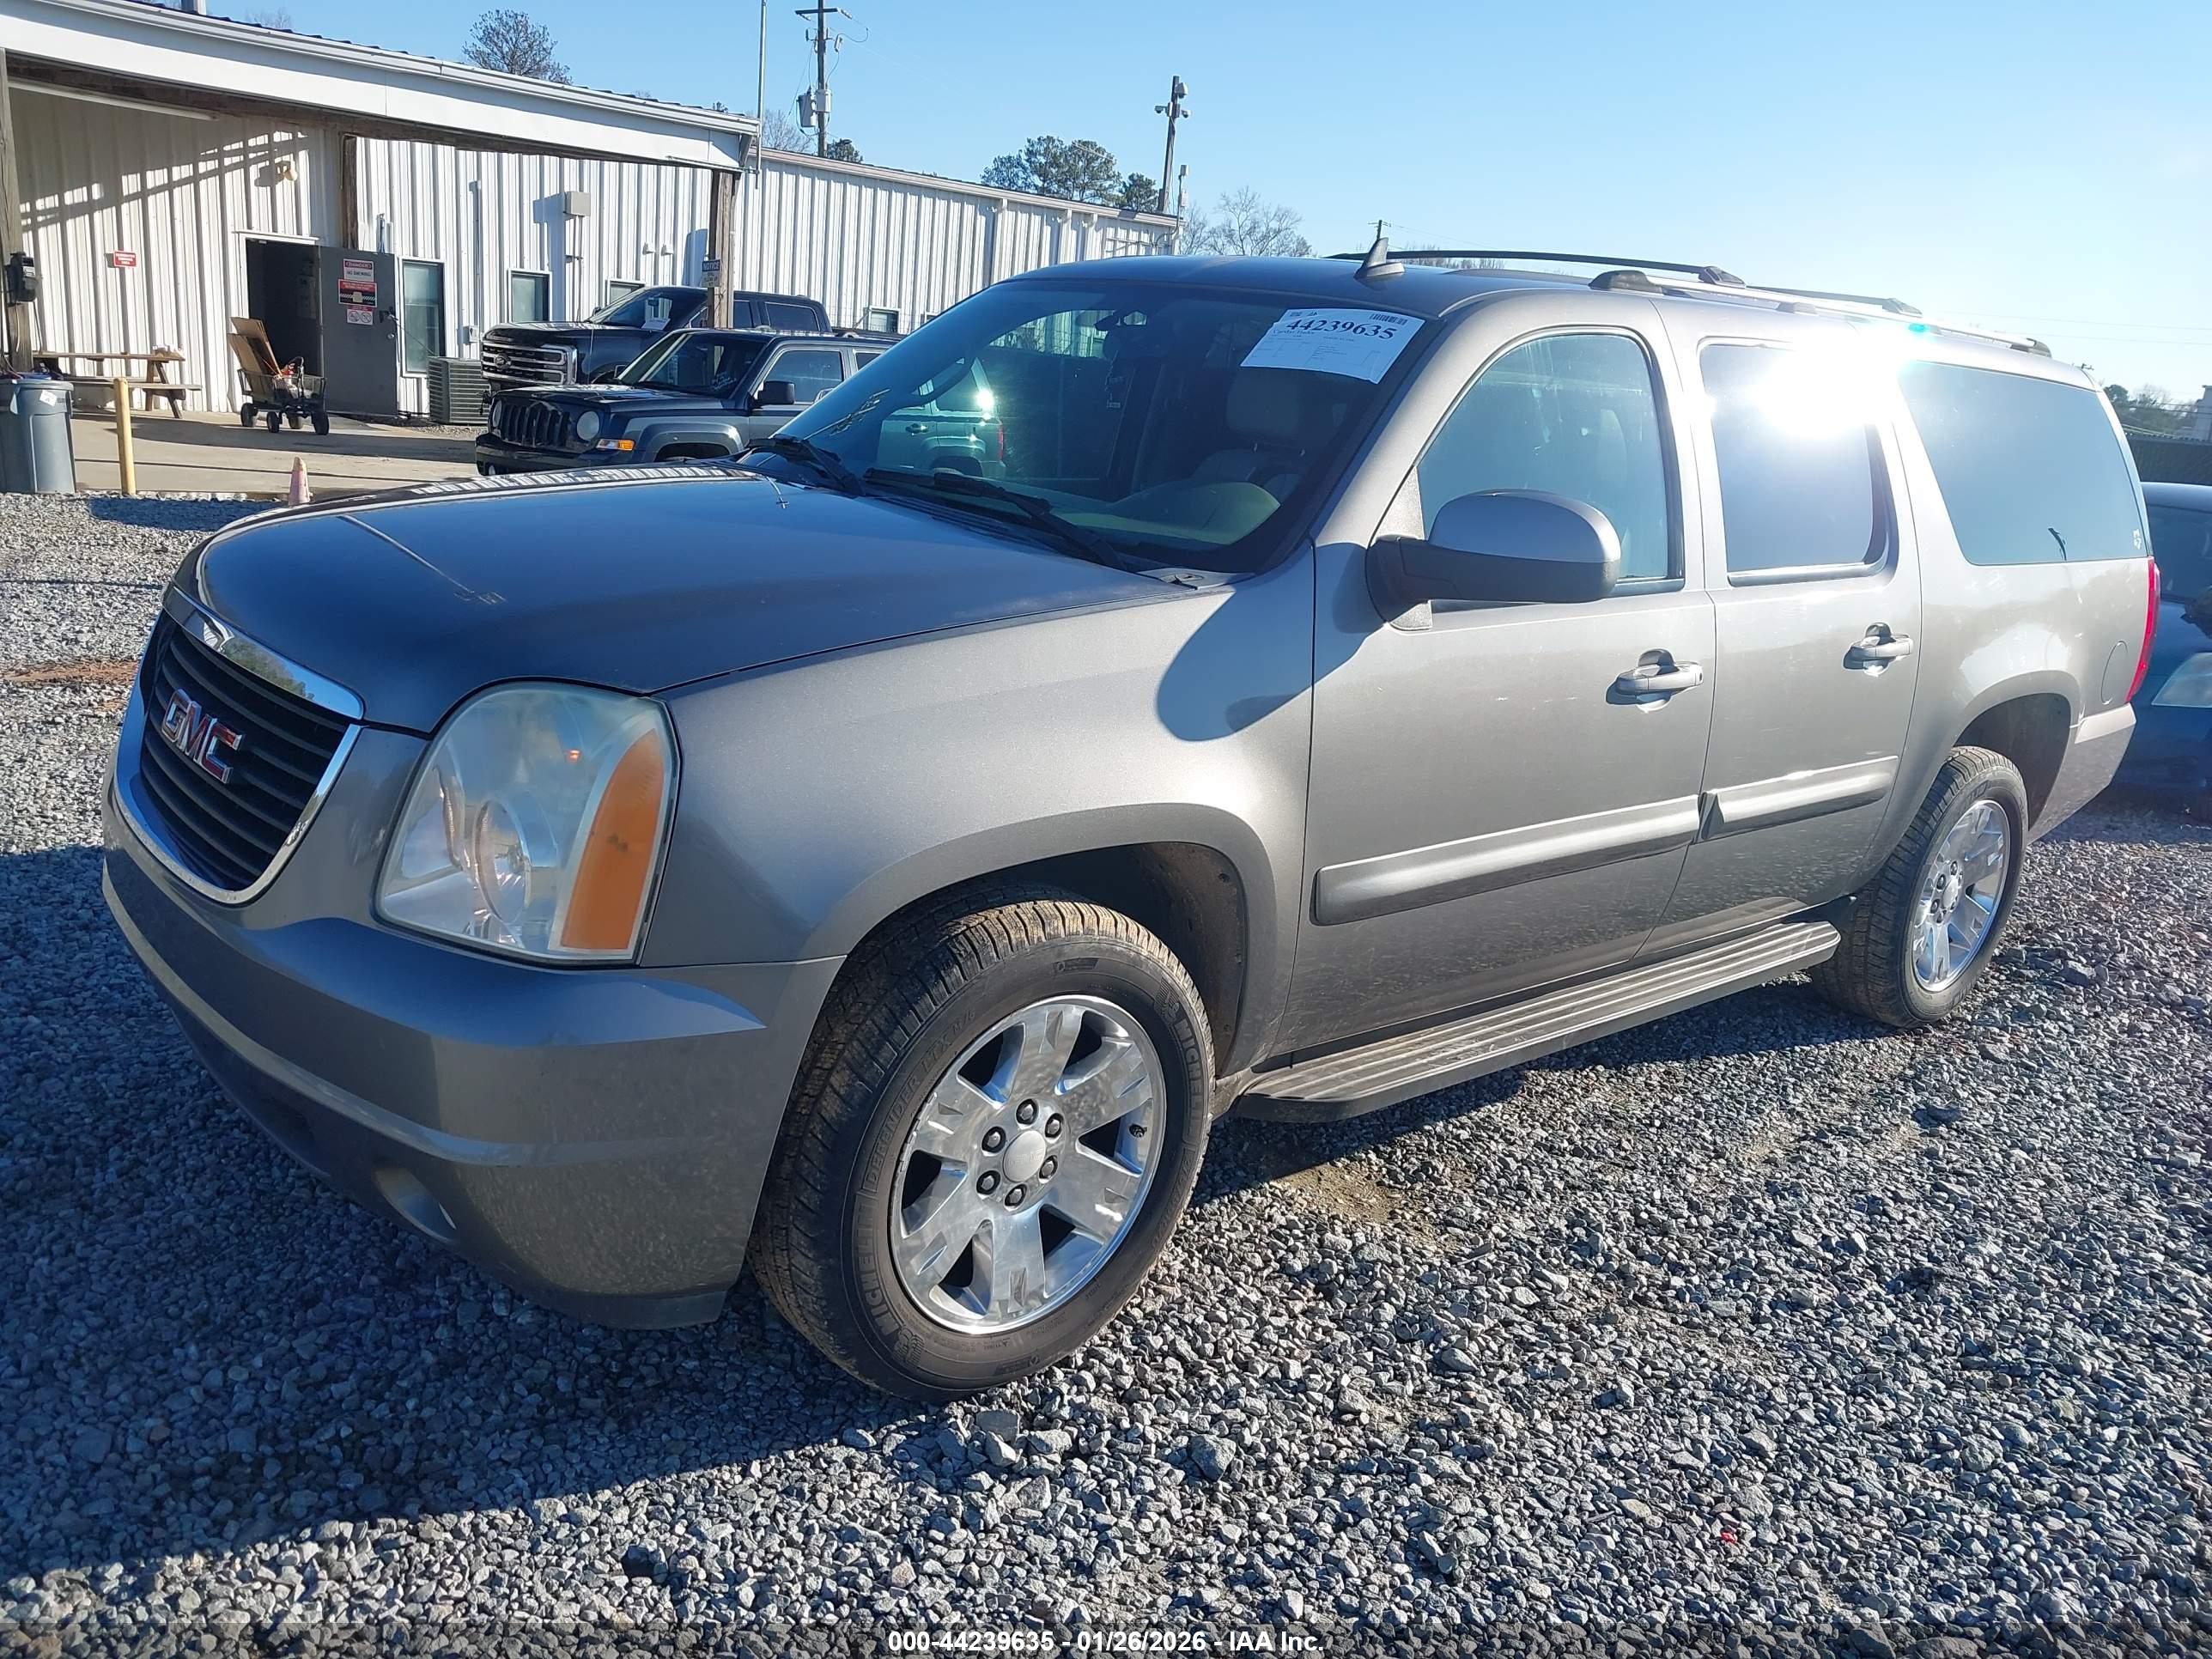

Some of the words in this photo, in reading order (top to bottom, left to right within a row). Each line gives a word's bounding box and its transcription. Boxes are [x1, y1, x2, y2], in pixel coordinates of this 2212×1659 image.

[703, 262, 720, 270] NOTICE
[1286, 319, 1397, 340] 44239635
[161, 689, 244, 784] GMC
[866, 1076, 921, 1184] DEFENDER
[921, 1036, 950, 1073] LTX
[1174, 1018, 1203, 1135] MICHELIN
[856, 1204, 899, 1336] MICHELIN
